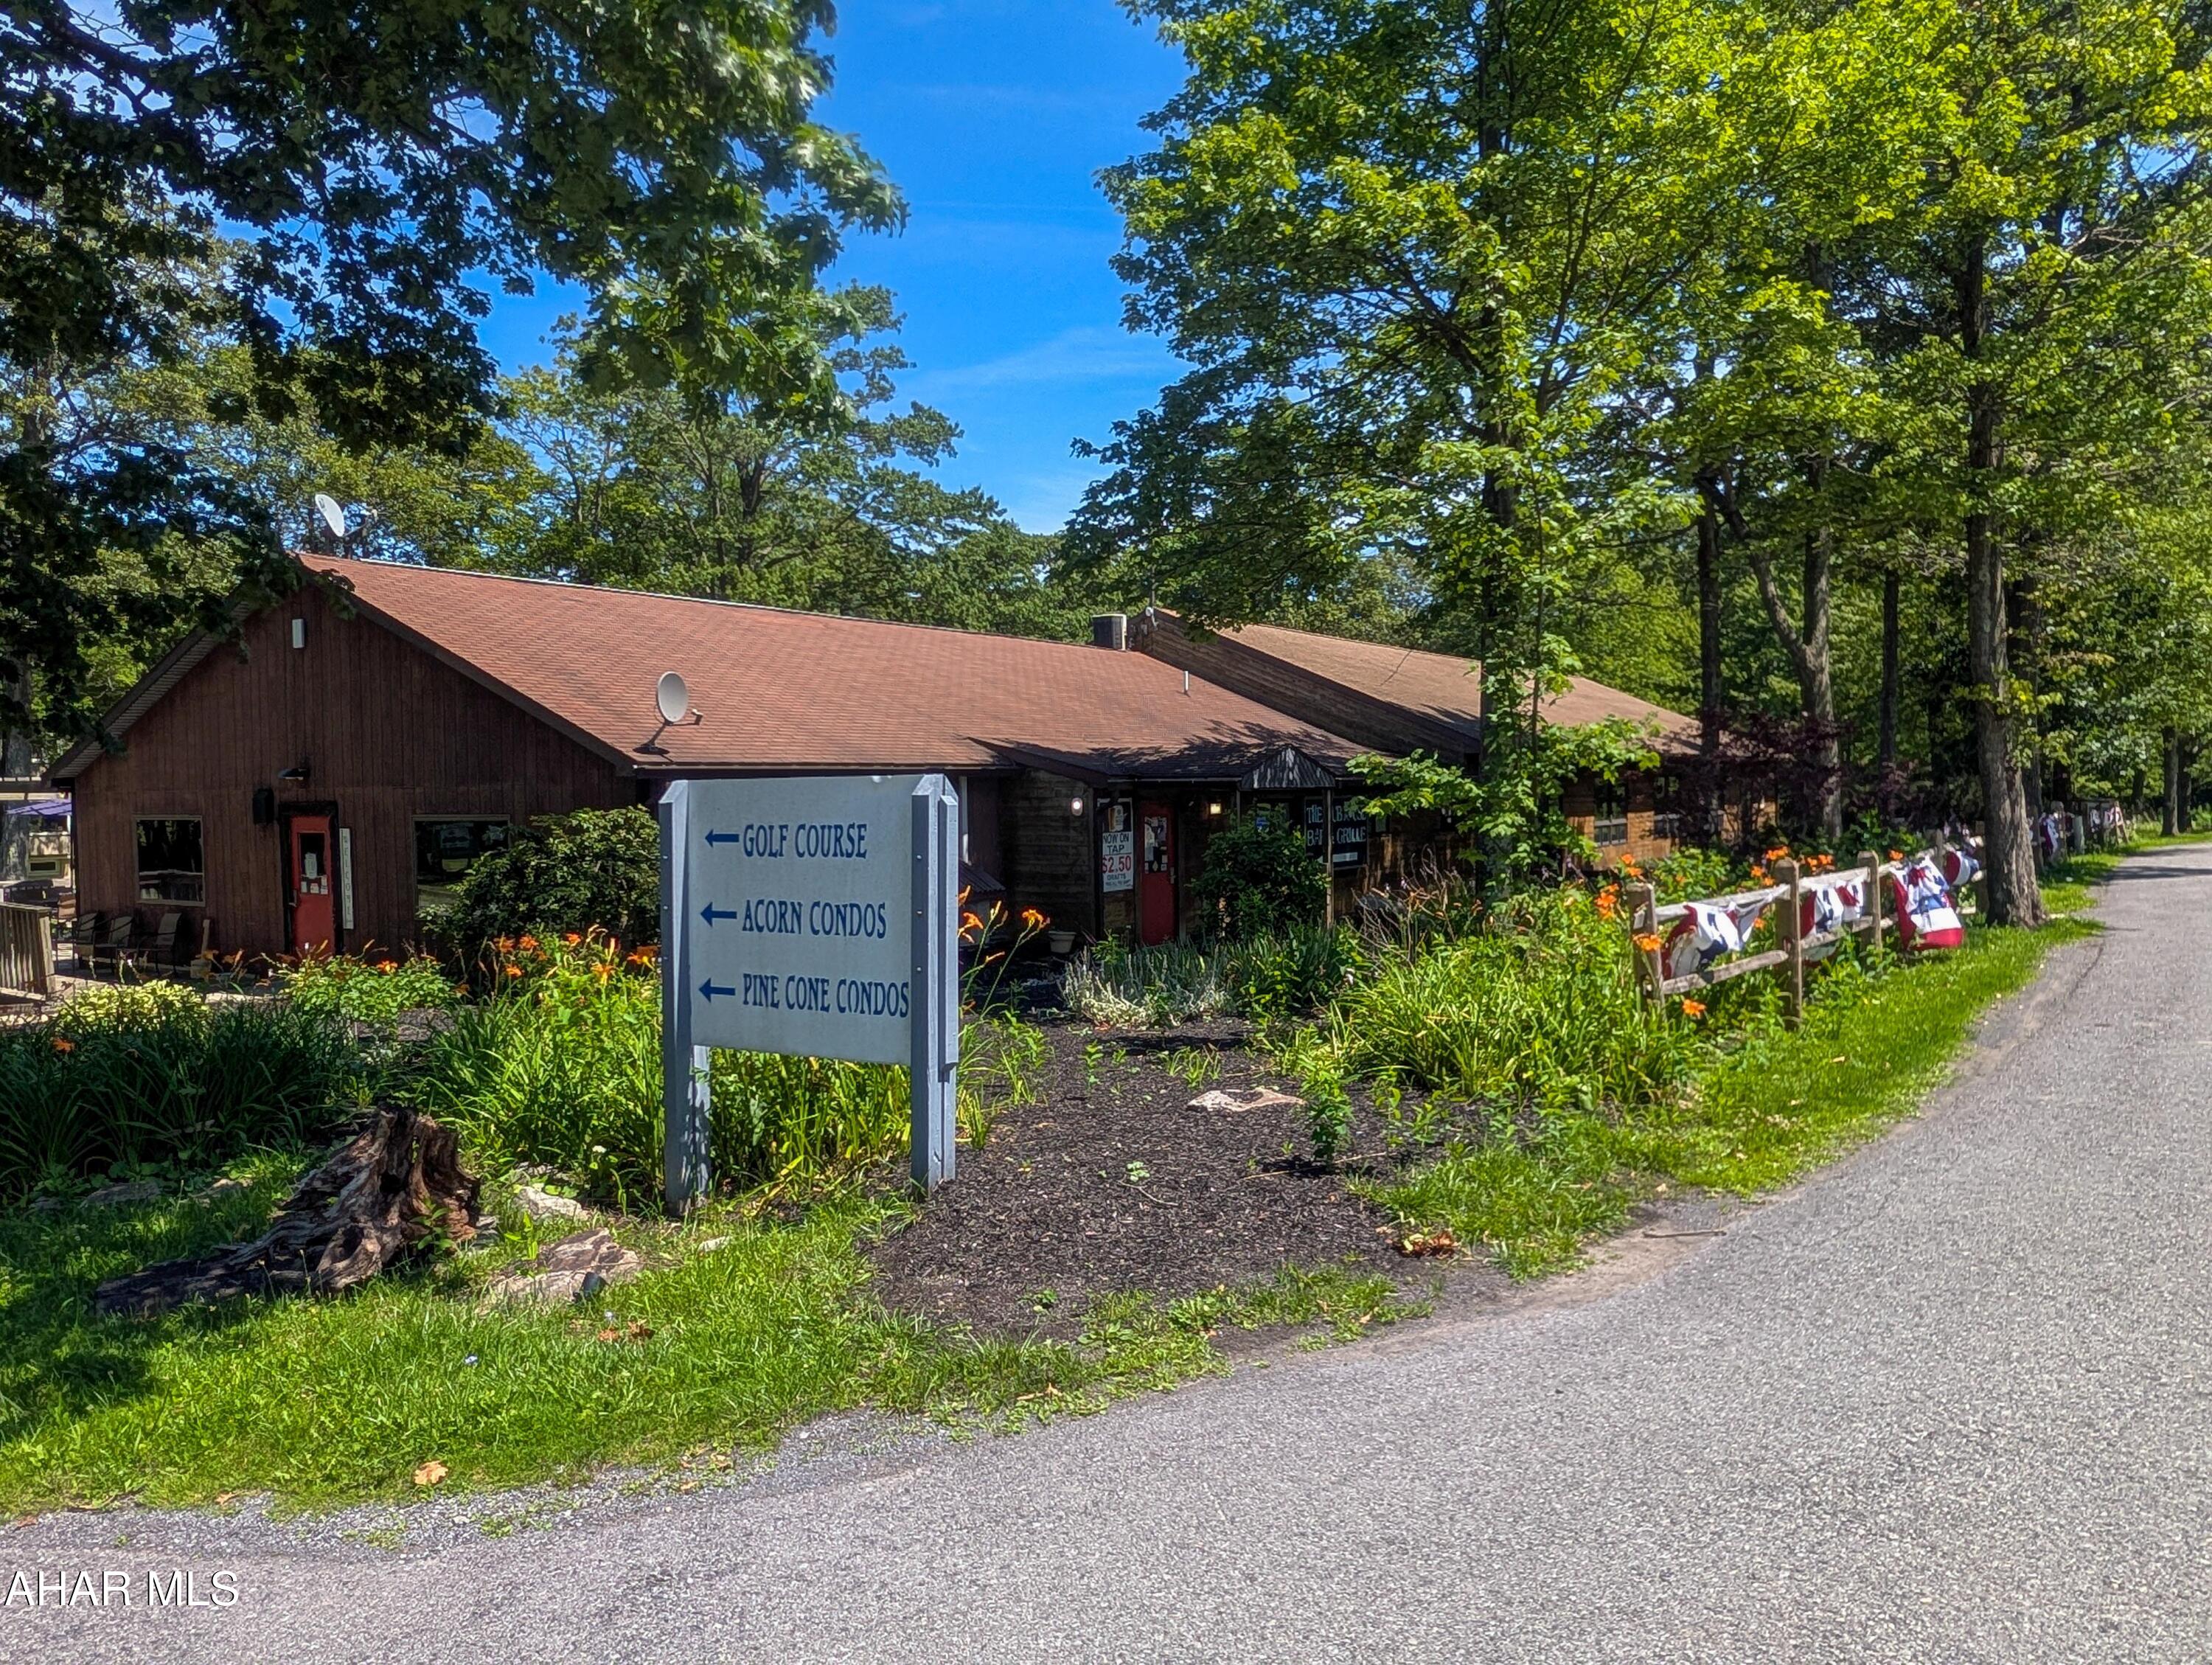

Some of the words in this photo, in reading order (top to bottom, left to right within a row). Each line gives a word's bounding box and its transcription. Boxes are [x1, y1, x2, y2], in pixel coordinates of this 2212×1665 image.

[1307, 804, 1323, 824] THE
[743, 823, 788, 858] GOLF
[795, 822, 867, 859] COURSE
[1103, 833, 1118, 844] NOW
[1120, 832, 1129, 843] ON
[1337, 827, 1366, 844] GRILLE
[1107, 844, 1124, 855] TAP
[1102, 855, 1131, 874] $2.50
[742, 899, 803, 934] ACORN
[810, 901, 886, 939] CONDOS
[742, 973, 779, 1009] PINE
[785, 974, 830, 1013] CONE
[836, 979, 909, 1018] CONDOS
